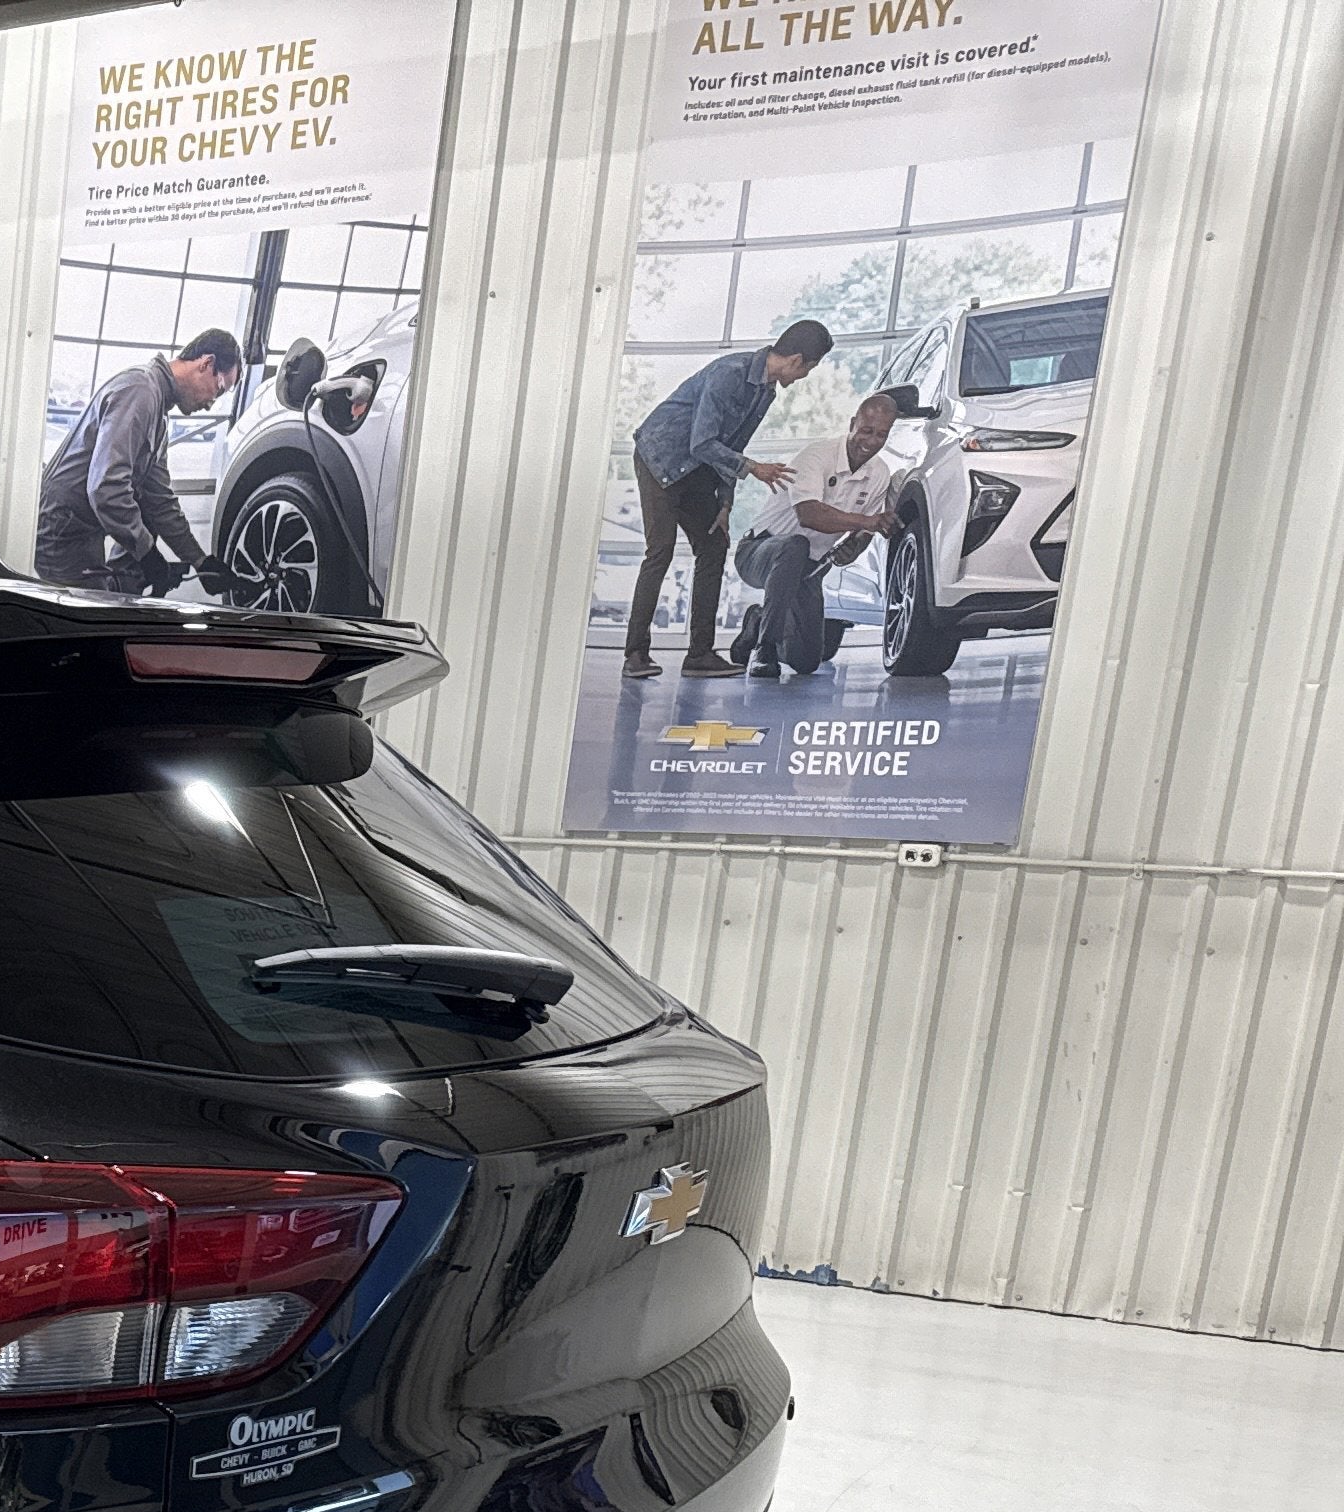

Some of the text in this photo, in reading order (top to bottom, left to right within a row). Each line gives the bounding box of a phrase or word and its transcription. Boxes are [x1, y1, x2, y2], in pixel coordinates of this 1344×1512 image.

[692, 0, 963, 55] ALL THE WAY.
[100, 39, 316, 94] WE KNOW THE
[689, 76, 725, 91] Your
[731, 72, 767, 88] first
[773, 60, 885, 84] maintenance
[890, 52, 929, 71] visit
[934, 49, 949, 65] is
[725, 99, 735, 107] oil
[738, 97, 753, 106] and
[756, 96, 765, 104] oil
[768, 94, 789, 103] filter
[792, 90, 826, 101] change,
[829, 87, 856, 97] diesel
[858, 83, 894, 94] exhaust
[896, 80, 917, 90] fluid
[919, 76, 939, 87] tank
[942, 72, 965, 84] refill
[967, 71, 984, 82] (for
[987, 59, 1066, 78] diesel-equipped
[1068, 52, 1111, 66] models),
[95, 74, 350, 132] RIGHT TIRES FOR
[710, 111, 746, 120] rotation,
[748, 109, 764, 117] and
[767, 103, 815, 115] Multi-Point
[818, 99, 850, 110] Vehicle
[852, 95, 902, 107] Inspection.
[92, 116, 336, 169] YOUR CHEVY EV.
[88, 174, 269, 200] Tire Price Match Guarantee.
[129, 217, 146, 225] price
[181, 213, 196, 221] days
[221, 208, 255, 218] purchase,
[194, 201, 211, 209] price
[793, 720, 940, 746] CERTIFIED
[650, 760, 767, 774] CHEVROLET
[788, 751, 910, 776] SERVICE
[4, 1217, 47, 1244] DRIVE
[230, 1407, 317, 1446] OLYMPIC
[221, 1437, 317, 1469] CHEVY BUICK GMC
[243, 1463, 294, 1485] HURON, SD
